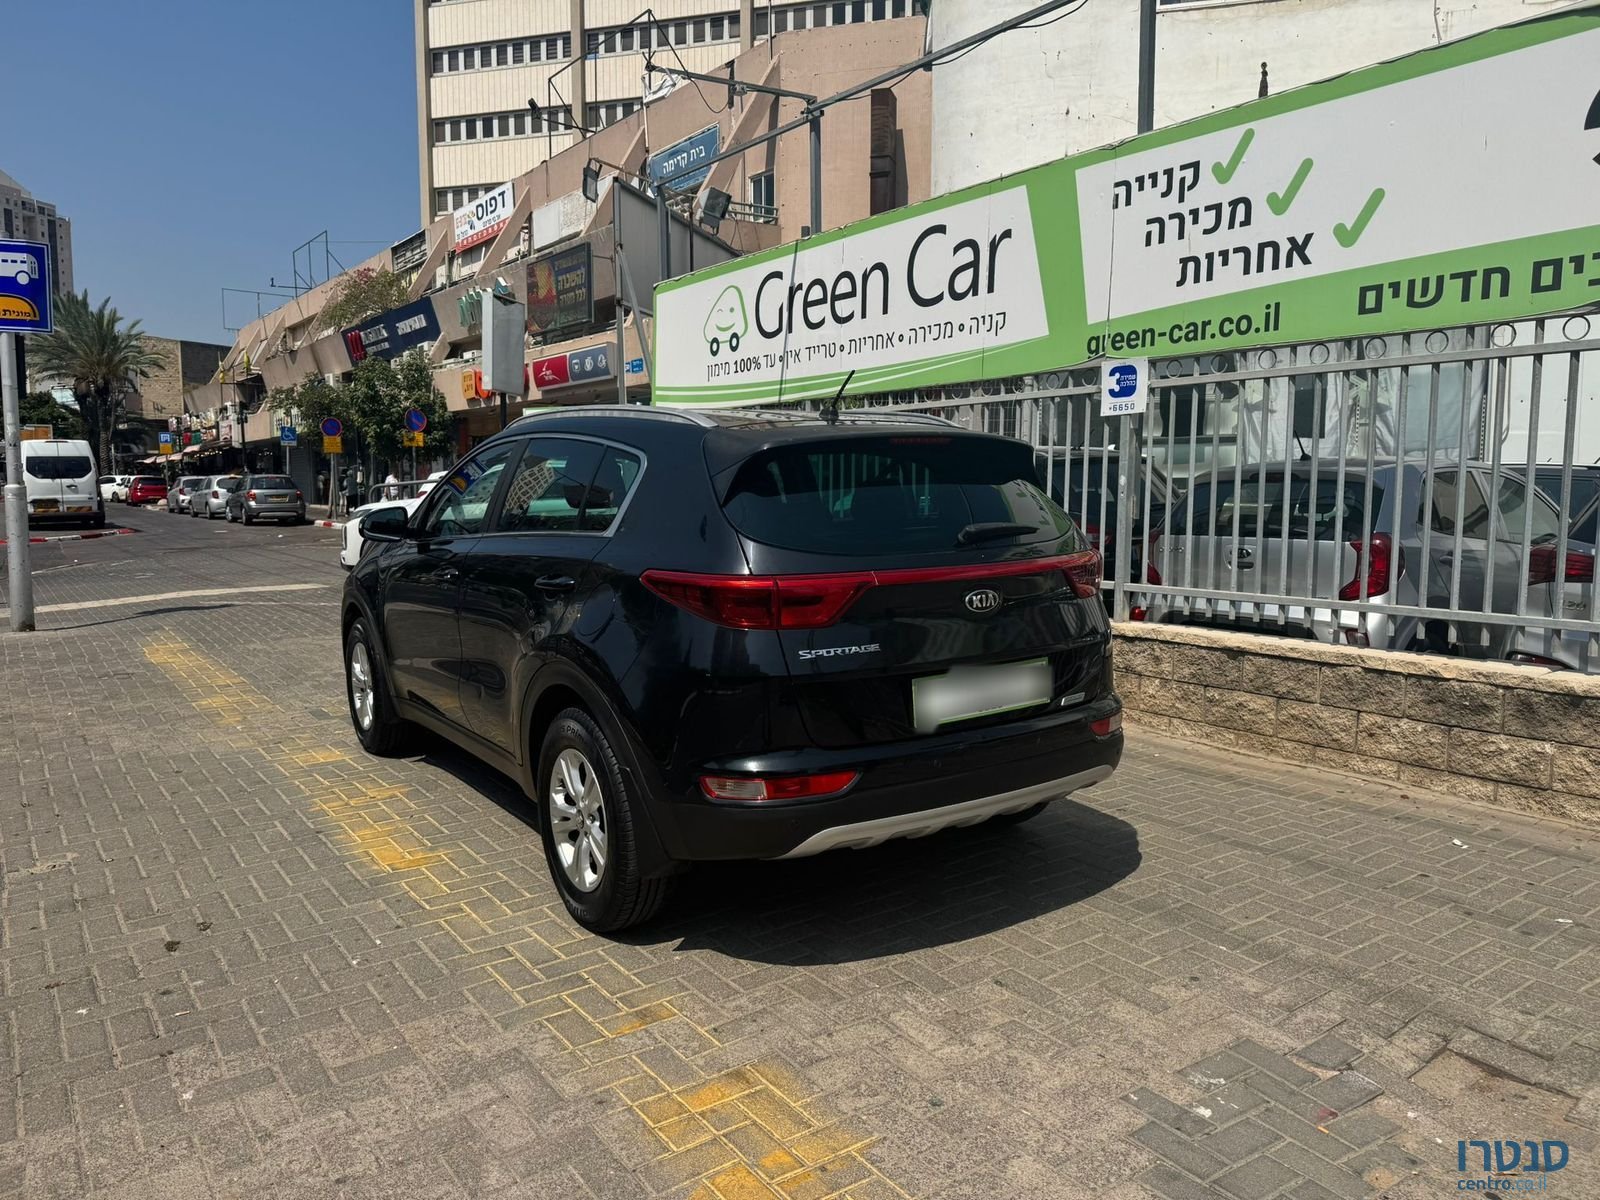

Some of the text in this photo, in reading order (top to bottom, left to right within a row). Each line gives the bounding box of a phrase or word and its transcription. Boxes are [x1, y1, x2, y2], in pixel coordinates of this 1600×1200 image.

[662, 145, 706, 175] בית קדימה
[1112, 159, 1201, 210] קנייה
[475, 189, 506, 221] דפוס
[1144, 196, 1253, 248] מכירה
[754, 223, 1013, 340] Green Car
[1175, 232, 1315, 288] אחריות
[2, 308, 31, 318] מונית
[1357, 265, 1511, 316] חדשים
[707, 311, 1007, 382] קניה מכירה אחריות טרייד אין עד 100% מימון
[1086, 301, 1281, 360] green-car.co.il
[798, 643, 881, 660] SPORTAGE
